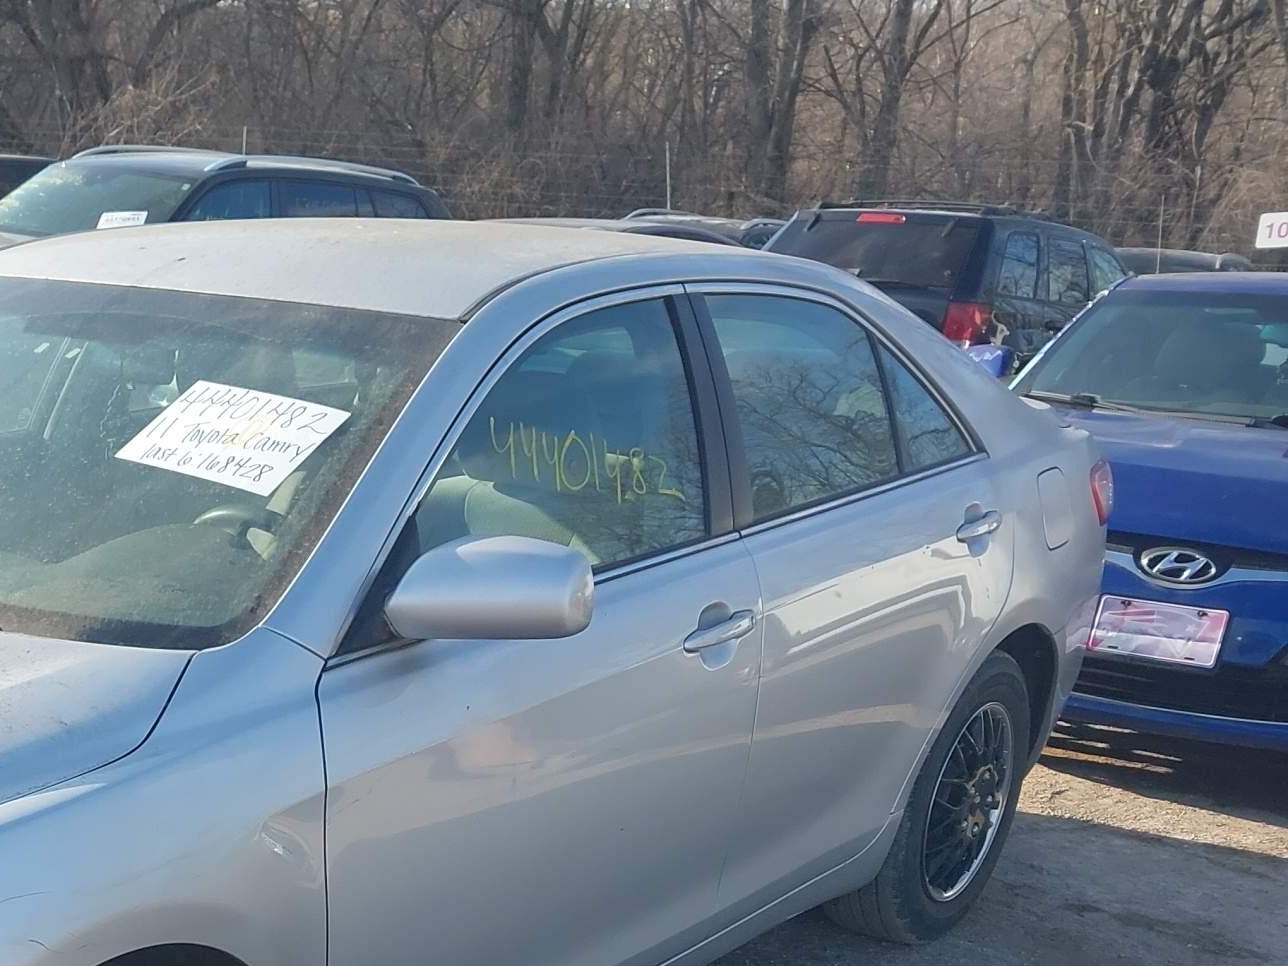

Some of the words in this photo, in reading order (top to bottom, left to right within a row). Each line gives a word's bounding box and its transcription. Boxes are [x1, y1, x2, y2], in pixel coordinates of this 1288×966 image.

[180, 386, 328, 435] 44401482
[139, 443, 178, 462] last
[183, 421, 240, 449] Toyota
[243, 431, 316, 463] Camry
[489, 416, 686, 504] 44401482
